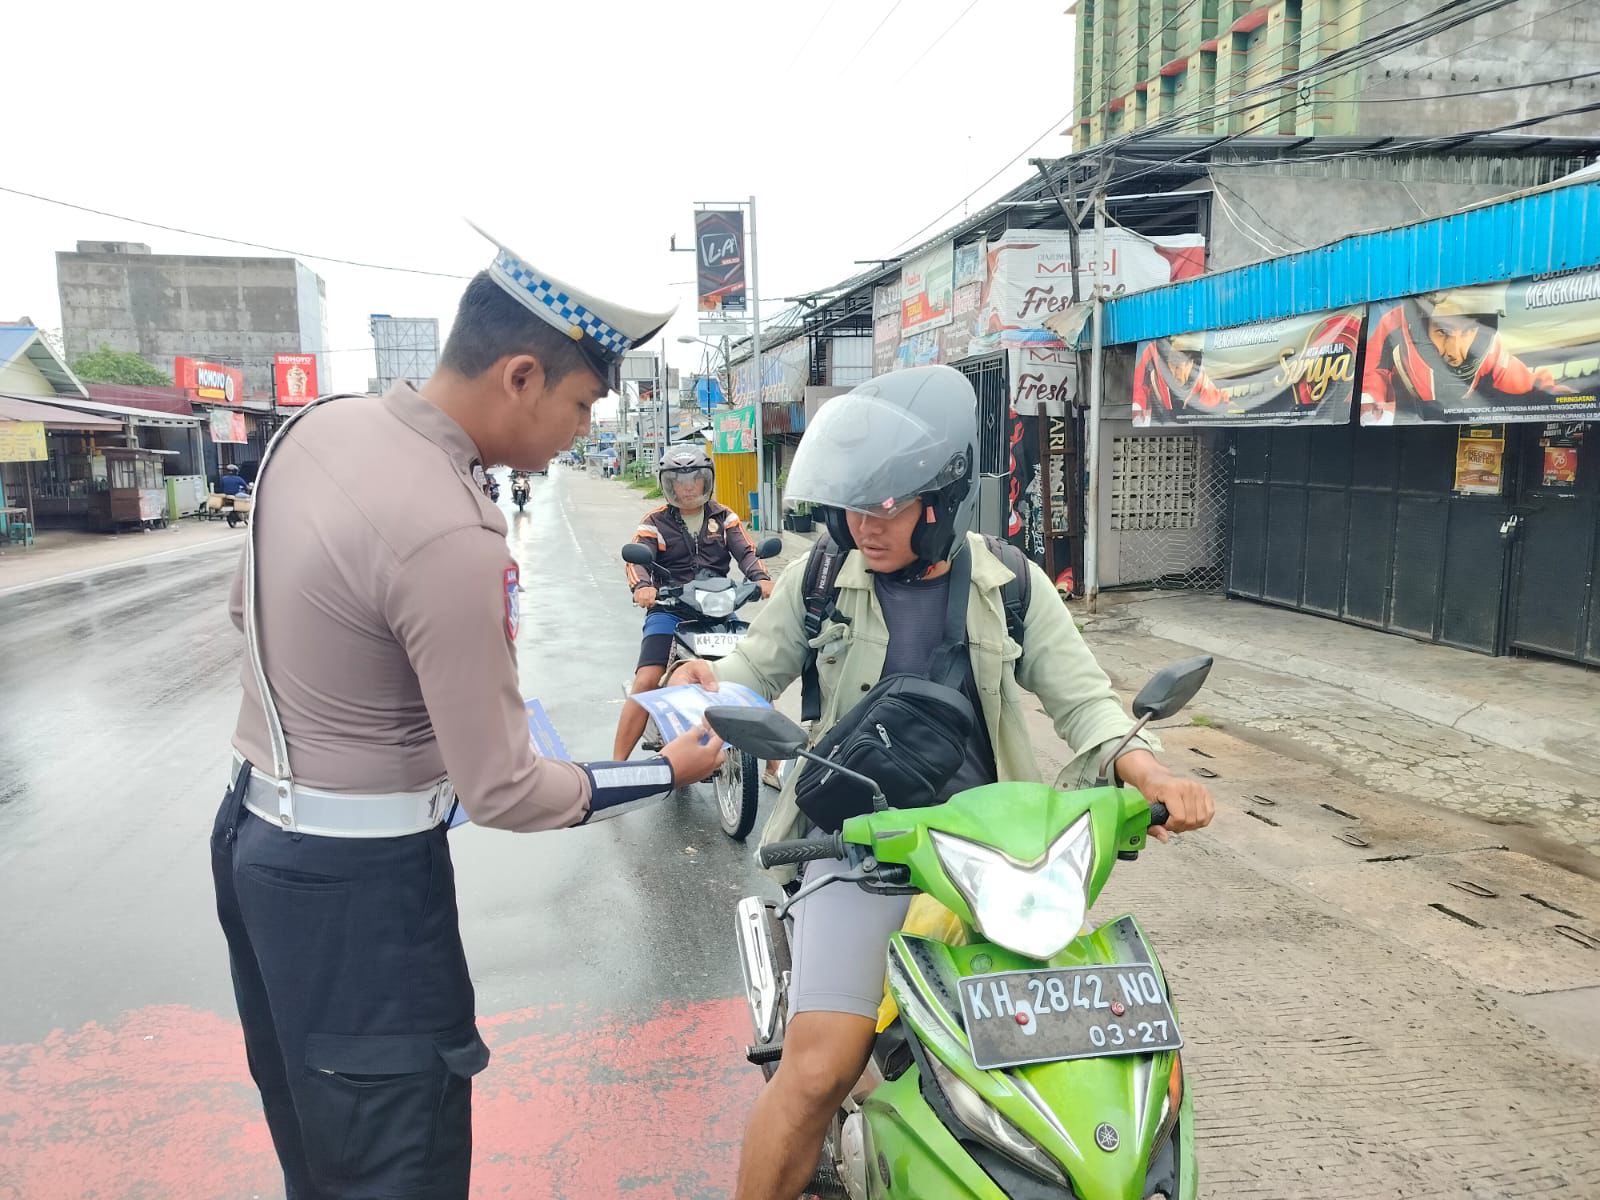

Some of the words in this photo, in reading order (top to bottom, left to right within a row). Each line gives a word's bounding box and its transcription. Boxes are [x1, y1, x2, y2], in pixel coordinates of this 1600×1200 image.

[1014, 372, 1068, 404] Fresh
[1274, 347, 1354, 401] Surya
[967, 980, 1015, 1020] KH
[1028, 974, 1108, 1014] 2842
